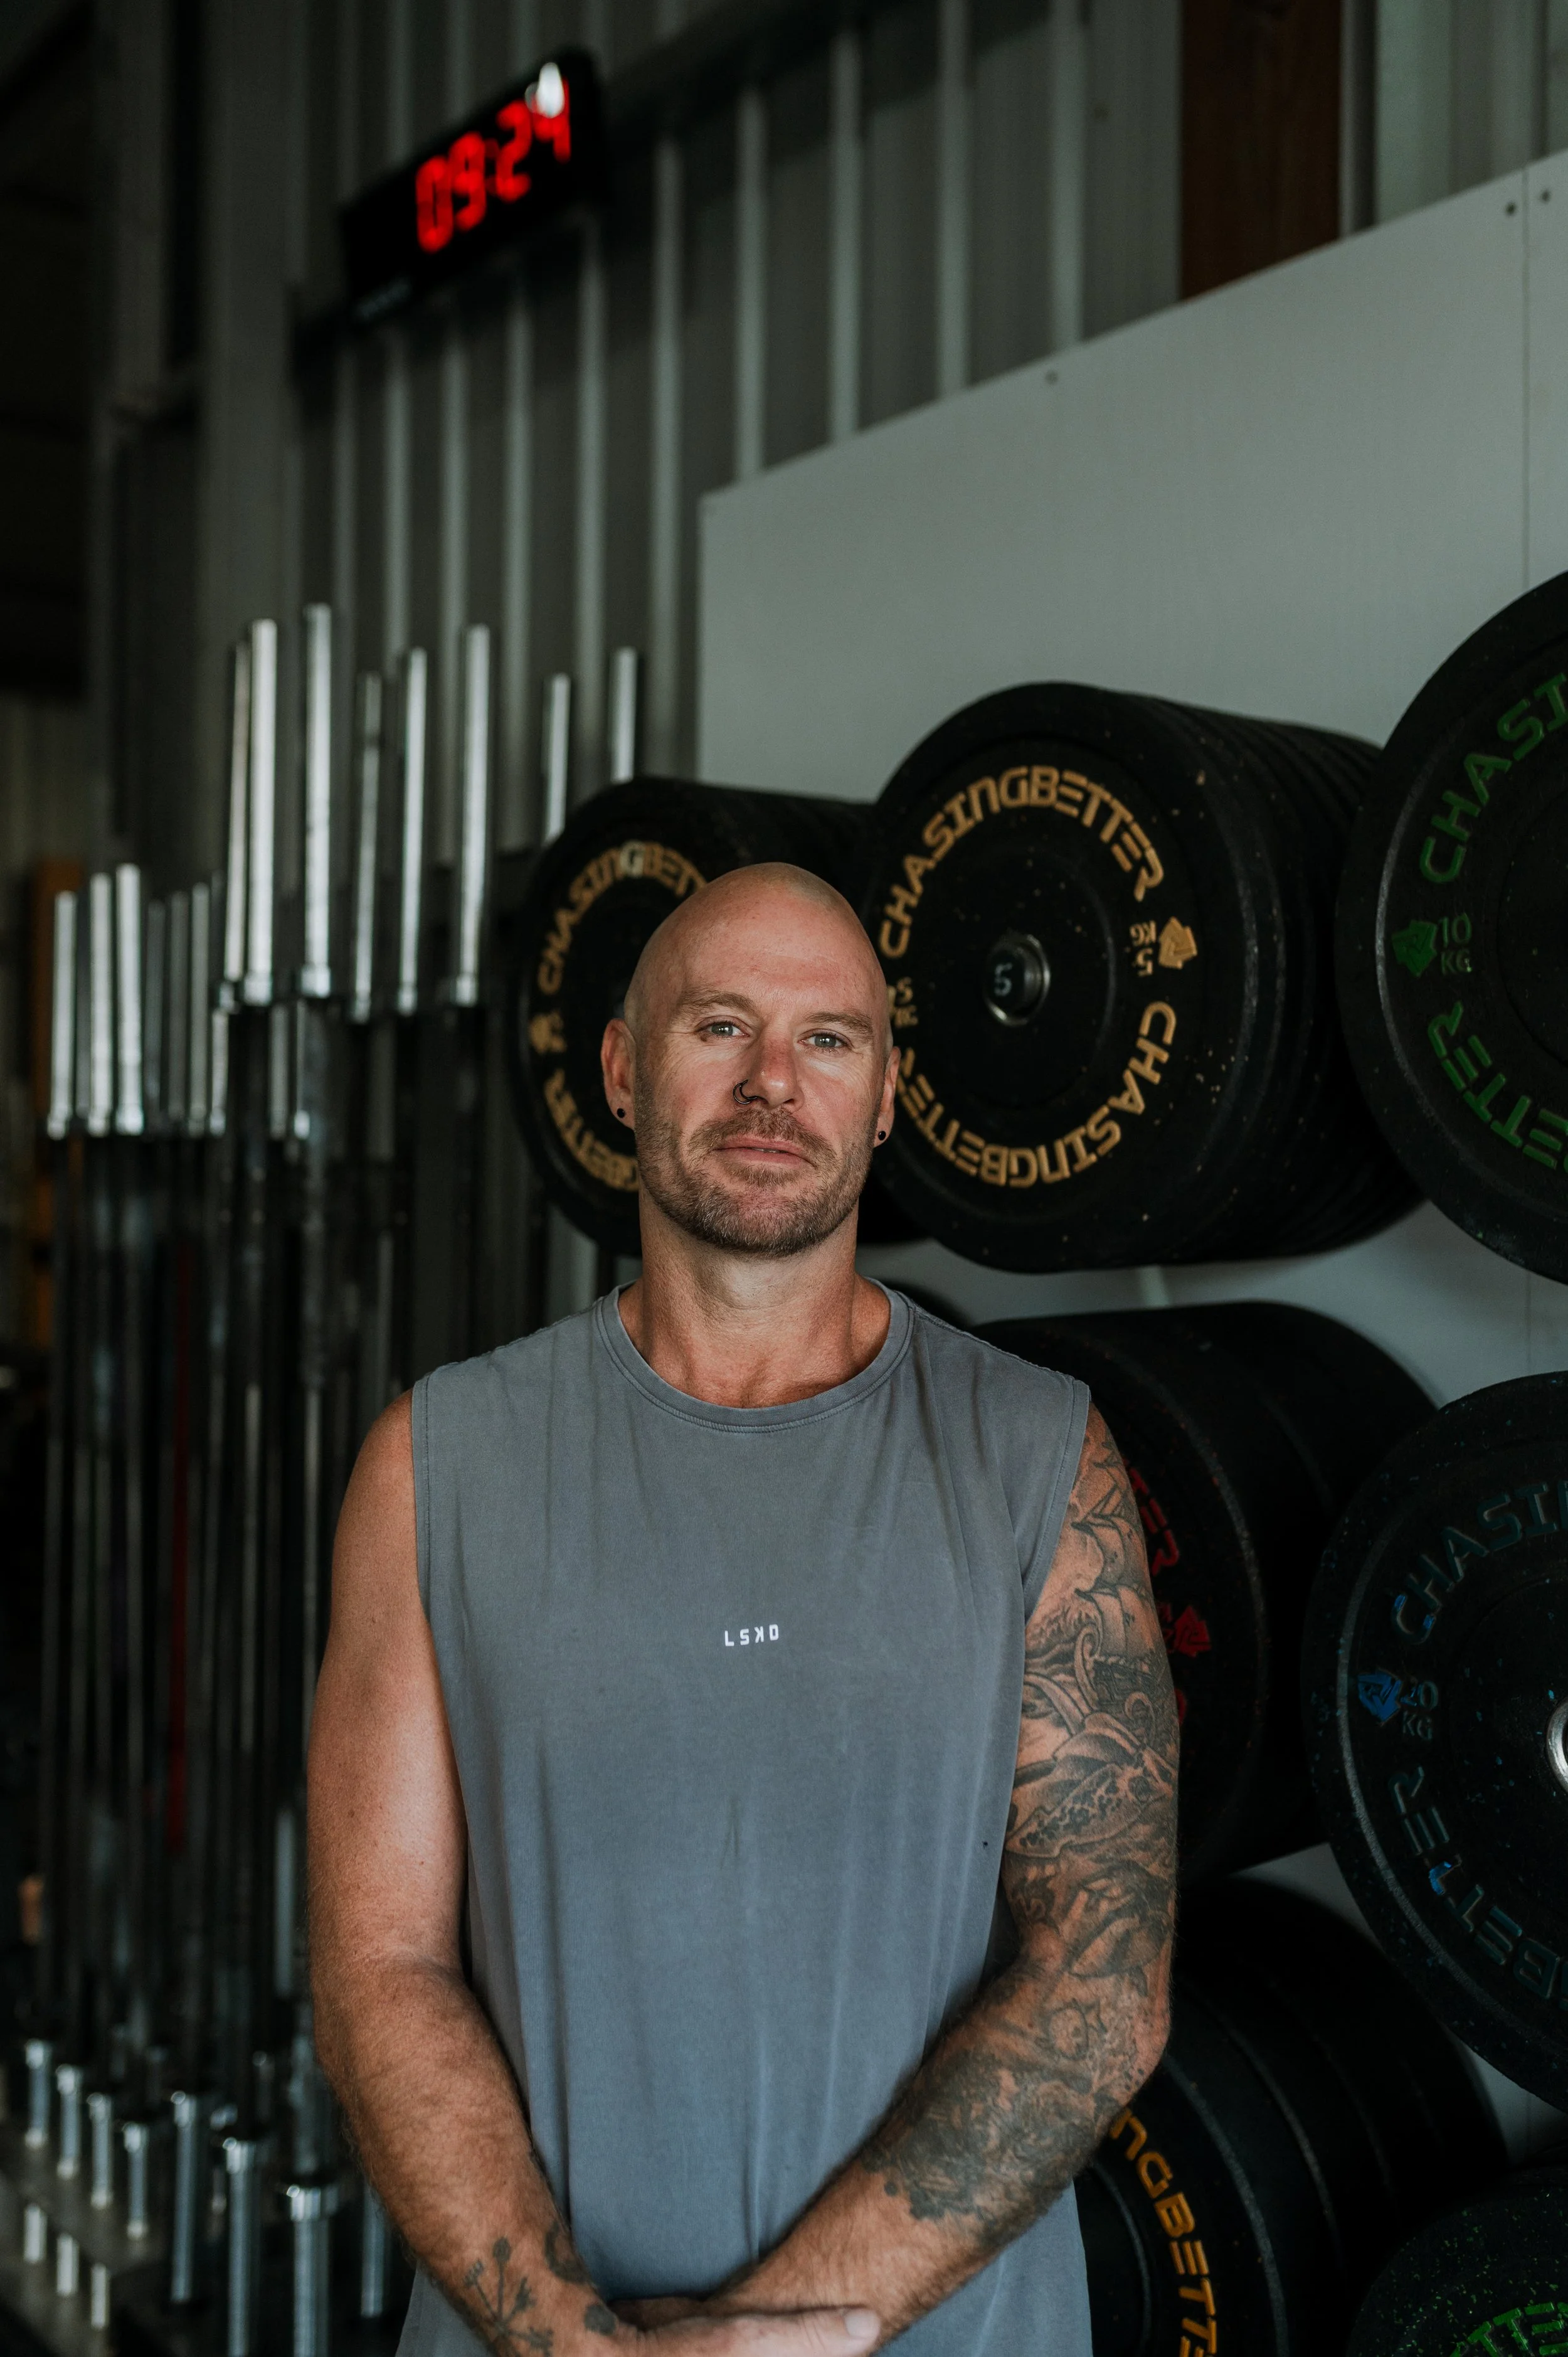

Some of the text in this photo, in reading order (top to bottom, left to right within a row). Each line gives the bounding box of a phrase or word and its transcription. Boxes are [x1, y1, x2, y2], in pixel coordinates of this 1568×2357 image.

[879, 764, 1165, 960] CHASINGBETTER
[1438, 912, 1473, 949] 10
[1441, 948, 1473, 976] KG
[1428, 1000, 1568, 1174] ETTER
[1387, 1764, 1568, 2011] BETTER
